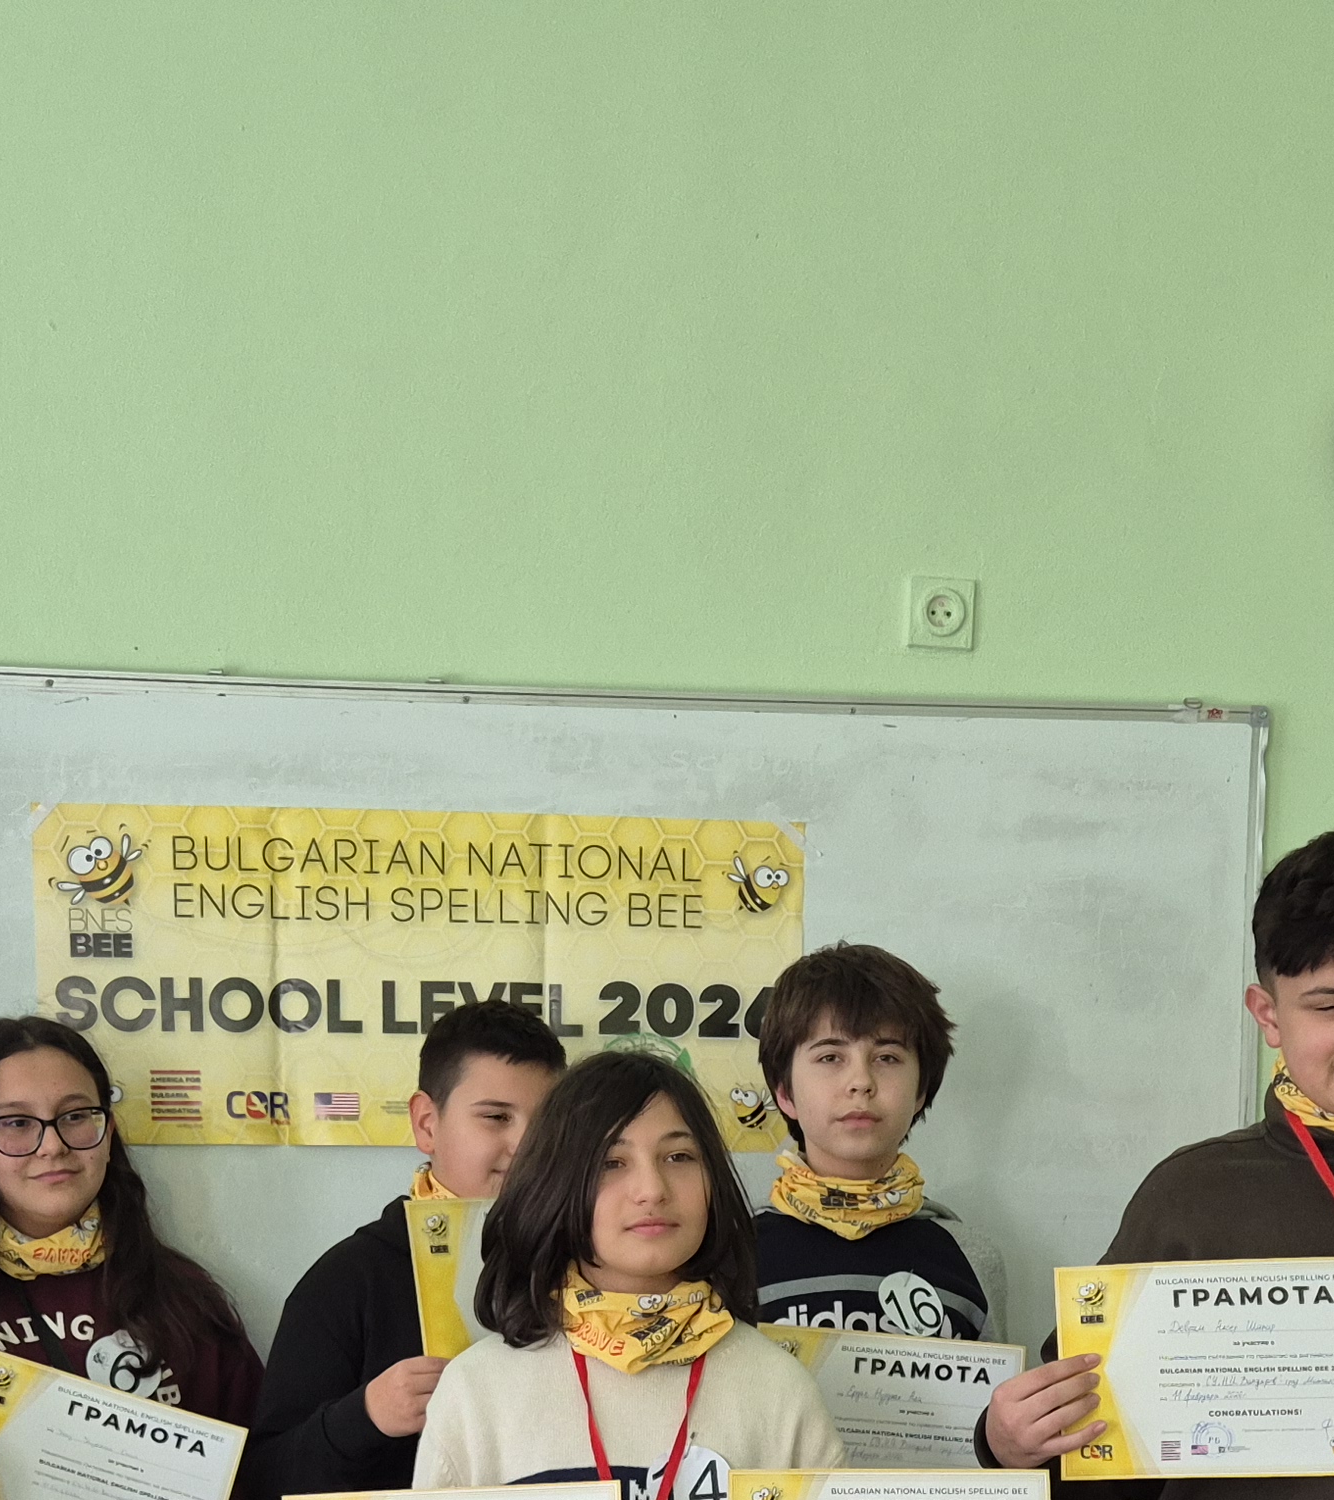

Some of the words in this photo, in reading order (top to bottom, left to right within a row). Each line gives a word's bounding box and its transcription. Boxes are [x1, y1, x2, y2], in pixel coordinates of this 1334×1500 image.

[172, 835, 445, 875] BULGARIAN
[468, 842, 702, 882] NATIONAL
[68, 907, 133, 932] BNES
[174, 883, 370, 921] ENGLISH
[390, 887, 609, 926] SPELLING
[628, 892, 703, 929] BEE
[69, 932, 134, 958] BEE
[55, 975, 363, 1034] SCHOOL
[1155, 1277, 1203, 1285] BULGARIAN
[1206, 1276, 1247, 1284] NATIONAL
[1251, 1274, 1286, 1282] ENGLISH
[1289, 1273, 1329, 1282] SPELLING
[1172, 1283, 1334, 1309] ГРАМОТА
[885, 1287, 942, 1330] 16
[109, 1350, 146, 1394] 6
[840, 1345, 883, 1354] BULGARIAN
[884, 1349, 921, 1358] NATIONAL
[923, 1353, 953, 1361] ENGLISH
[955, 1355, 990, 1364] SPELLING
[851, 1356, 990, 1384] ГРАМОТА
[57, 1385, 100, 1404] BULGARIAN
[101, 1399, 139, 1416] NATIONAL
[140, 1412, 173, 1427] ENGLISH
[173, 1422, 209, 1438] SPELLING
[210, 1434, 225, 1443] BEE
[67, 1399, 208, 1458] ГРАМОТА
[1208, 1408, 1302, 1418] CONGRATULATIONS!
